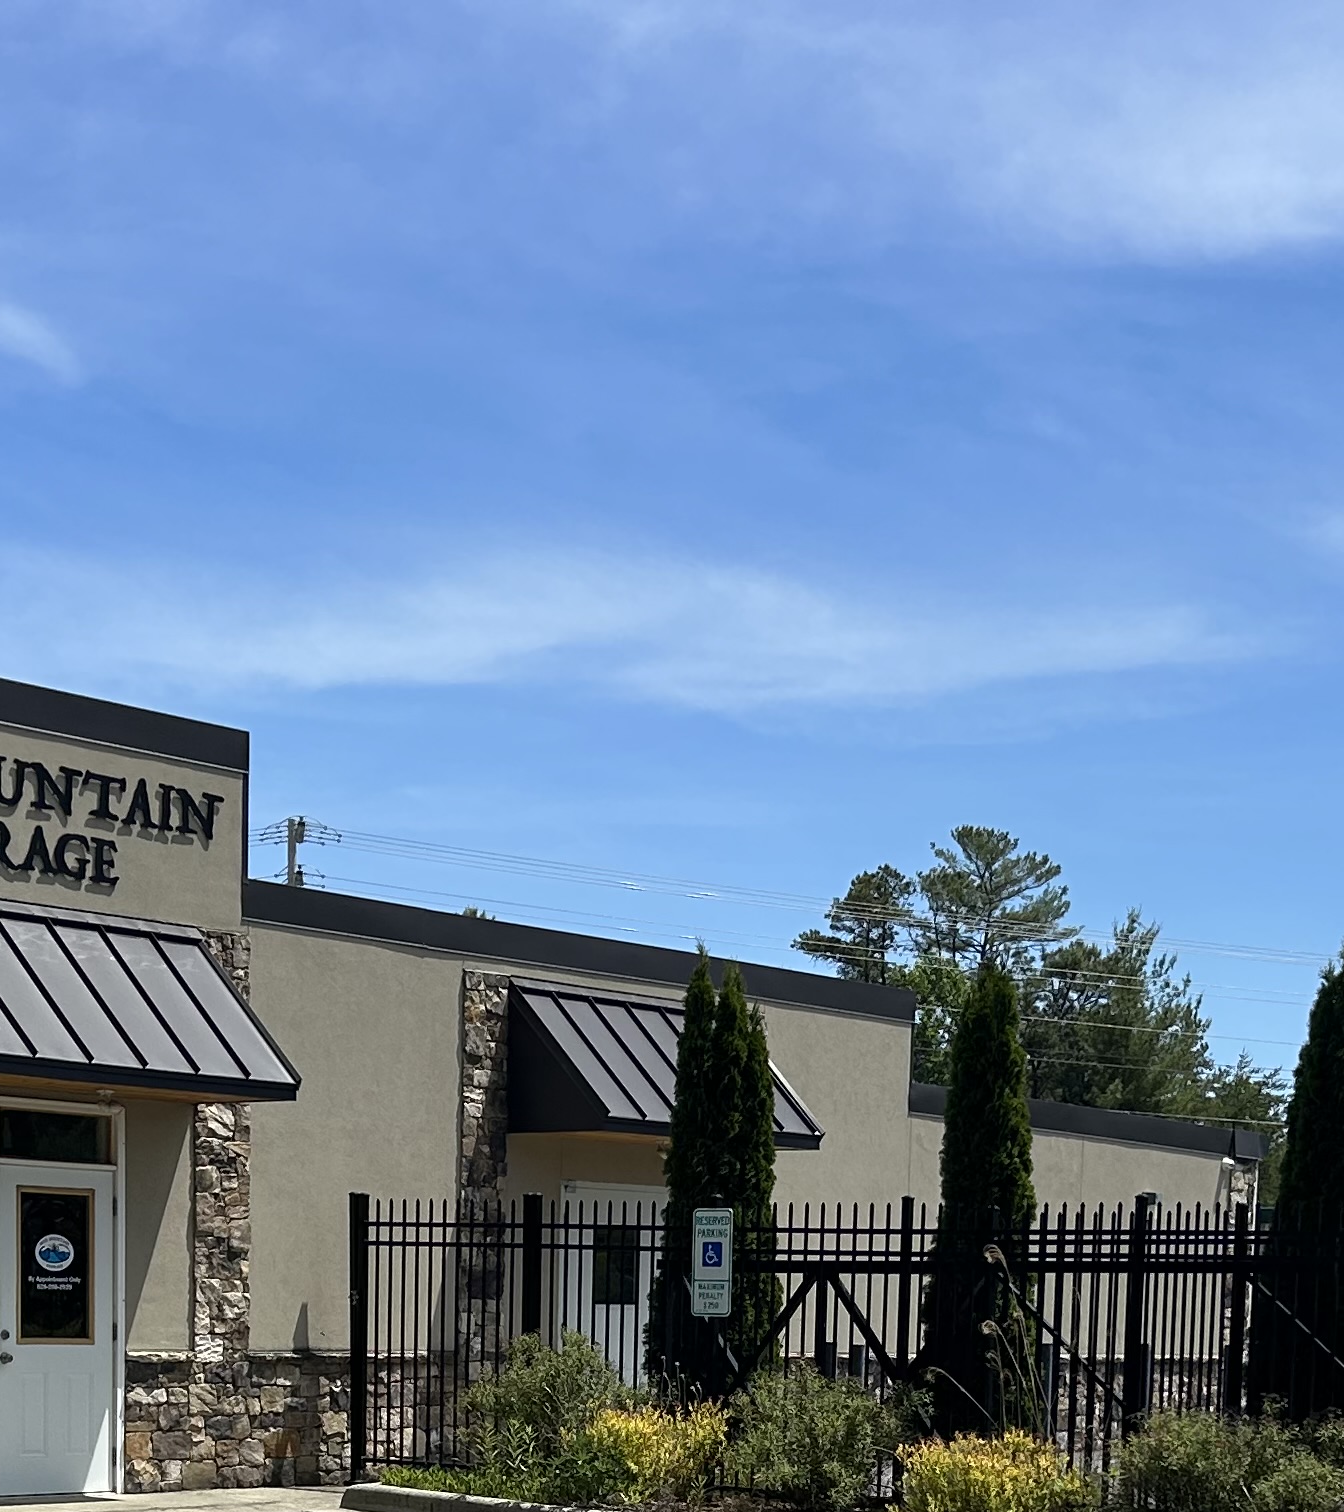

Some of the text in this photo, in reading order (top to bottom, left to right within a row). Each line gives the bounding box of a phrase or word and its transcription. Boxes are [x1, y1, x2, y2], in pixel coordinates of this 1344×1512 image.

[696, 1215, 730, 1226] RESERVED
[697, 1228, 728, 1238] PARKING
[698, 1292, 724, 1300] PENALTY
